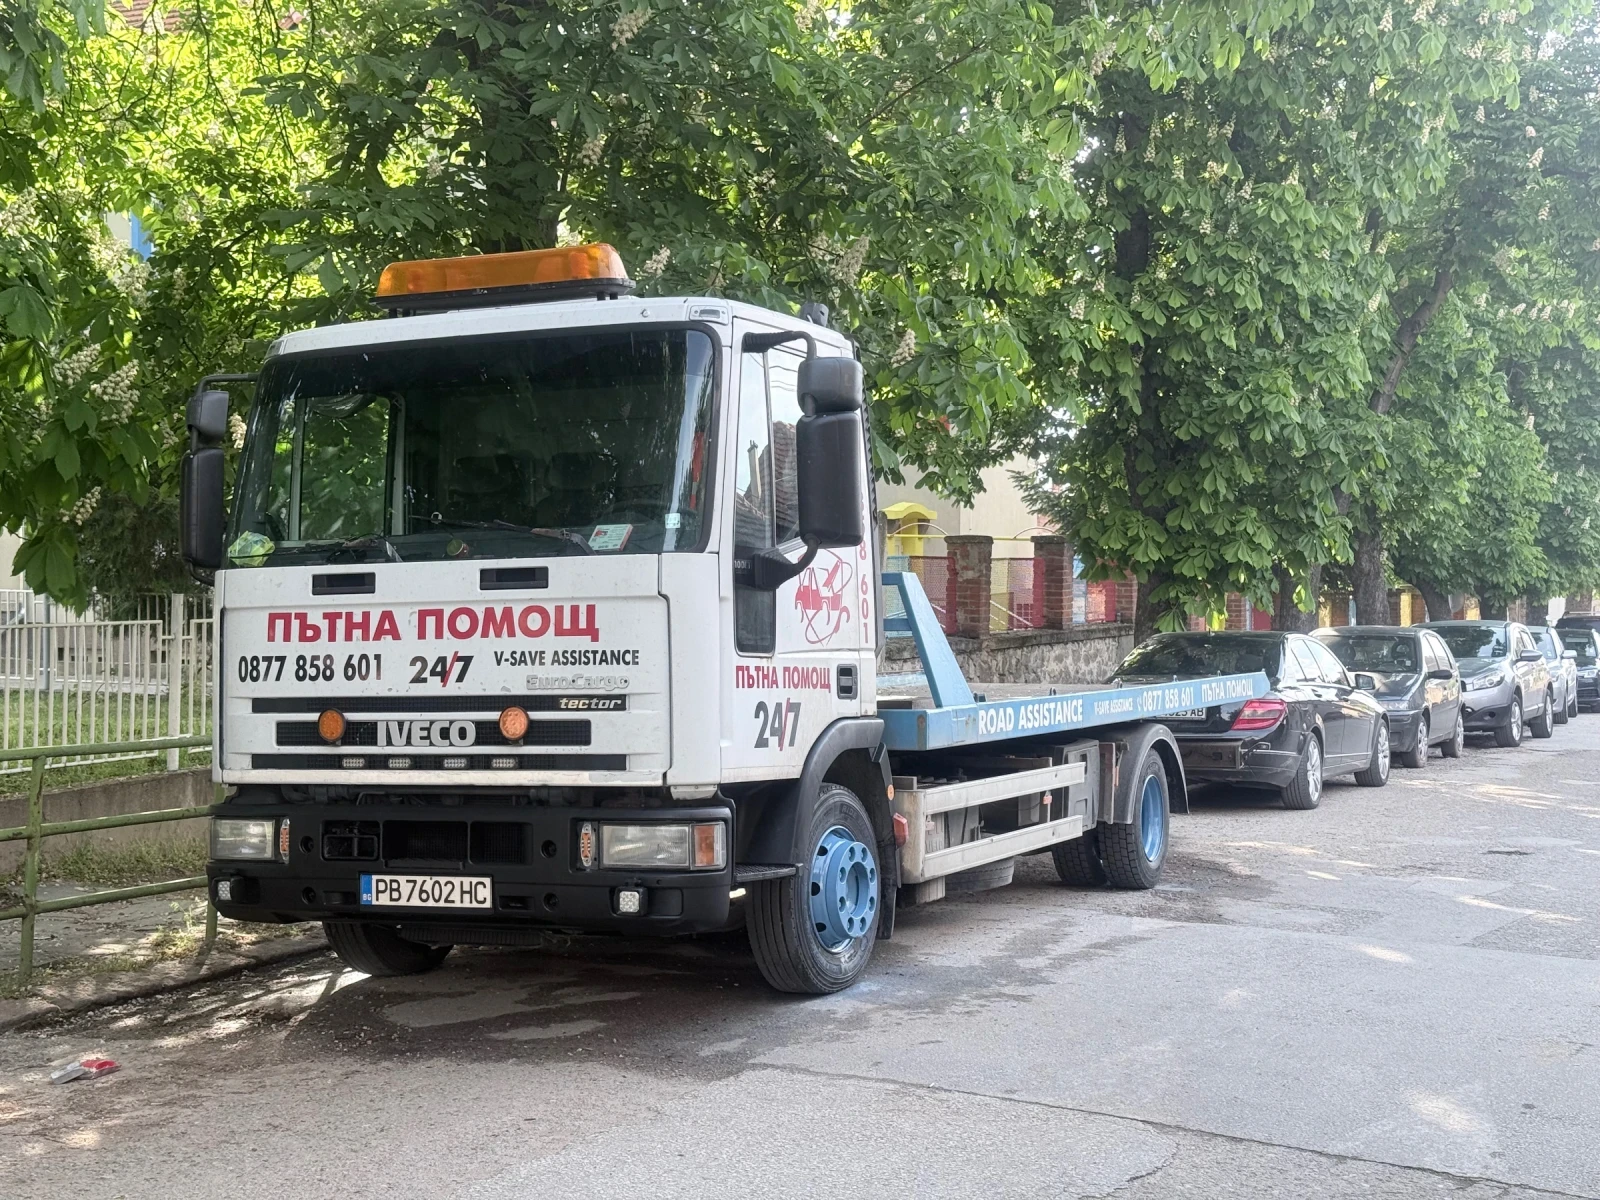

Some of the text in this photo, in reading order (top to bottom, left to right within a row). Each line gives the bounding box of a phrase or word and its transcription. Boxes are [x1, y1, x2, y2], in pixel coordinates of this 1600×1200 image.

[267, 604, 599, 643] ПЪТНА ПОМОЩ
[238, 653, 382, 682] 0877 858 601
[409, 651, 474, 687] 24/7
[494, 649, 640, 667] V-SAVE ASSISTANCE
[526, 673, 630, 691] EuroCargo
[735, 665, 831, 693] ПЪТНА ПОМОЩ
[1201, 678, 1254, 703] ПЪТНА ПОМОЩ
[559, 697, 622, 709] tector
[1142, 686, 1194, 711] 0877 858 601
[754, 697, 801, 751] 24/7
[978, 698, 1083, 735] ROAD ASSISTANCE
[377, 720, 476, 747] IVECO
